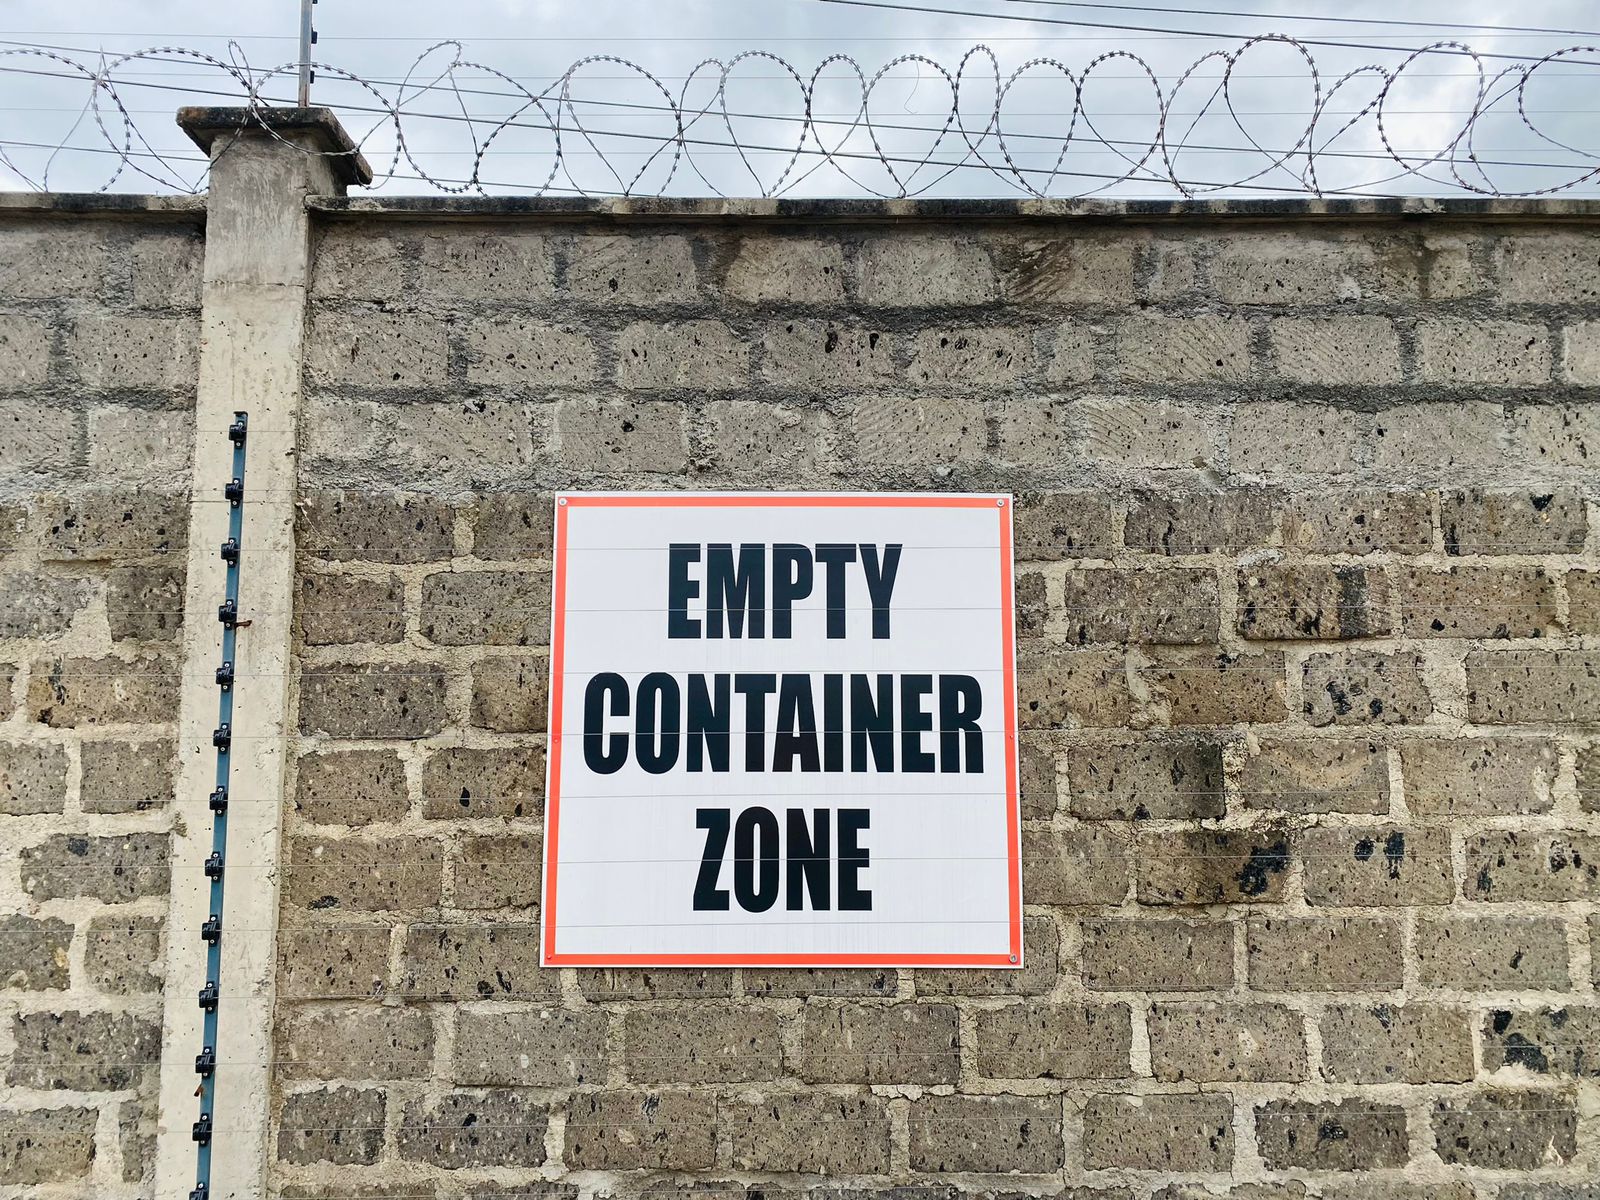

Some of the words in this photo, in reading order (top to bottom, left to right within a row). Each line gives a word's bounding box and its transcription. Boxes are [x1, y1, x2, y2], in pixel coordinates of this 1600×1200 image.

[668, 543, 903, 639] EMPTY
[583, 673, 984, 774] CONTAINER
[693, 807, 873, 913] ZONE
